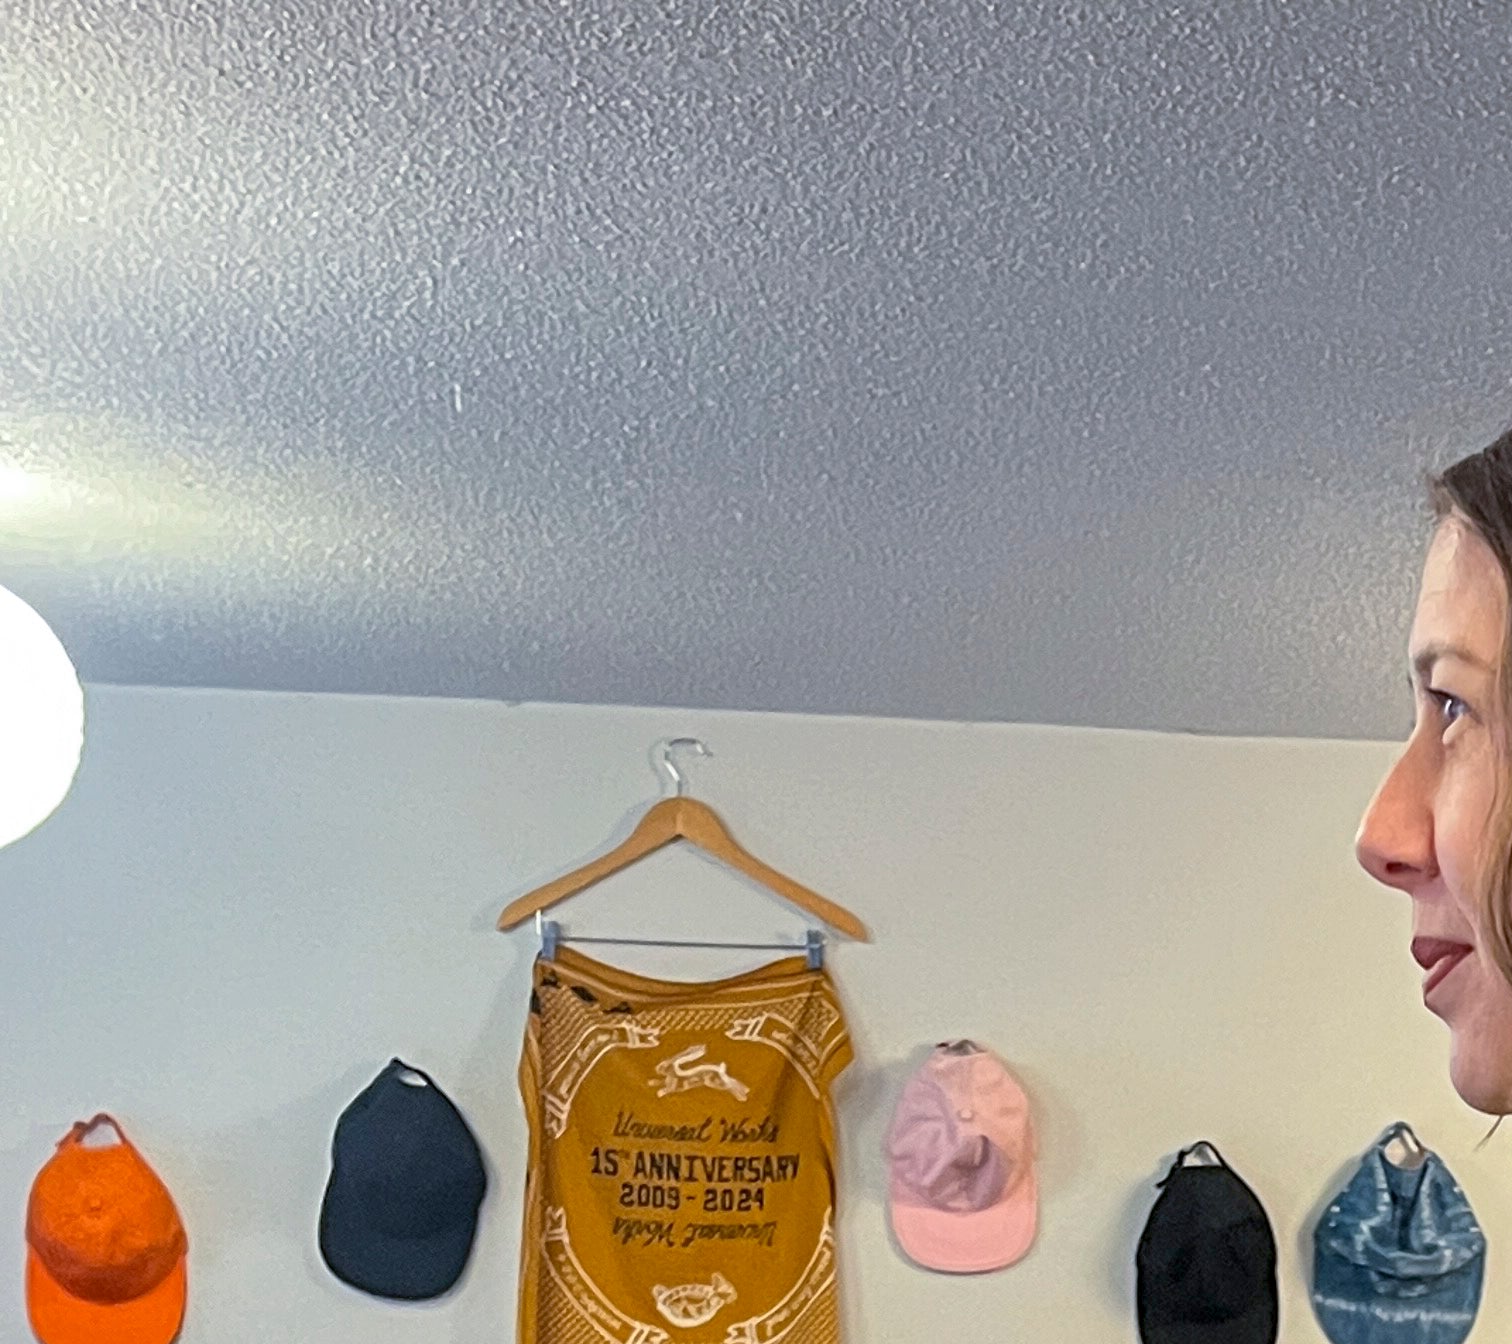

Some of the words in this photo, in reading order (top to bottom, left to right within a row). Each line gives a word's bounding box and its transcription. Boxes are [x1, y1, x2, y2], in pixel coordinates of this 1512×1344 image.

[633, 1151, 800, 1183] ANNIVERSARY
[619, 1182, 680, 1211] 2009
[702, 1187, 765, 1213] 2024
